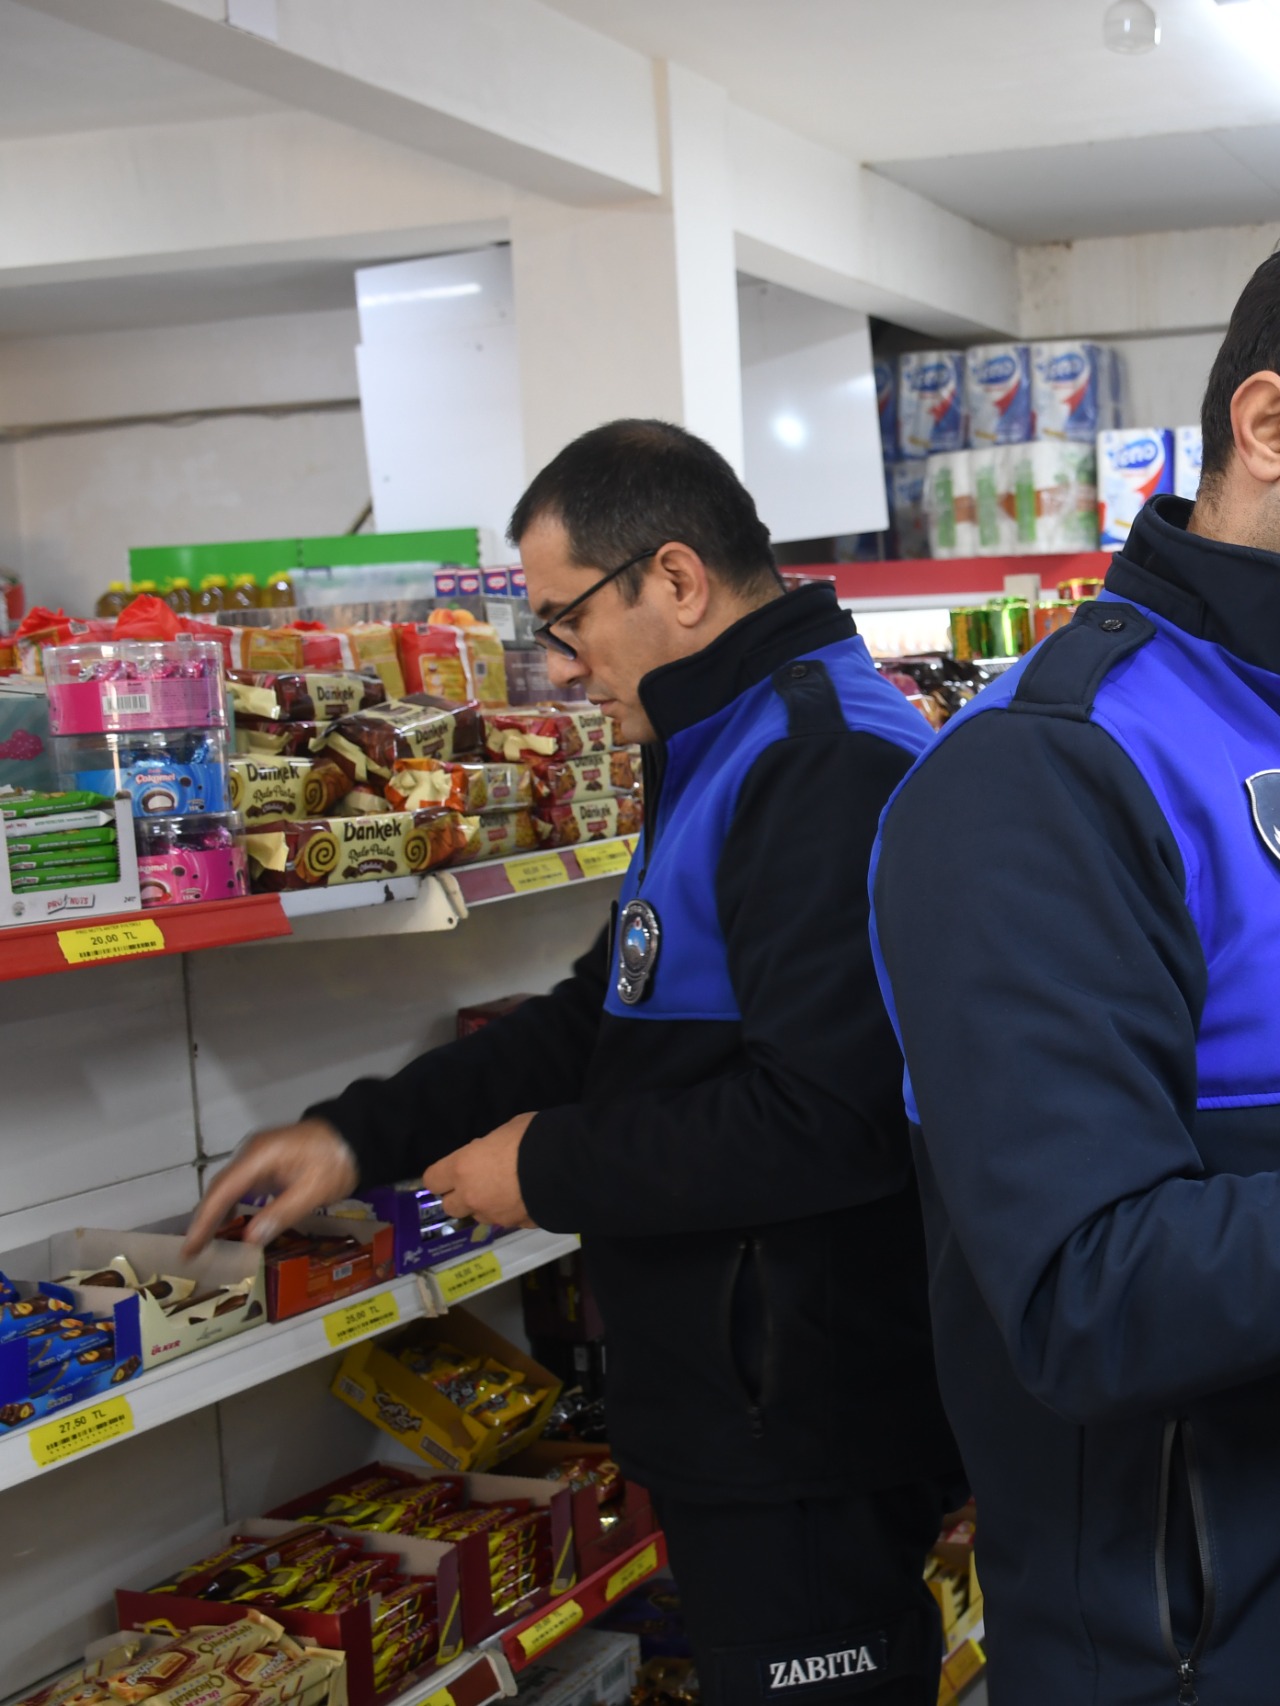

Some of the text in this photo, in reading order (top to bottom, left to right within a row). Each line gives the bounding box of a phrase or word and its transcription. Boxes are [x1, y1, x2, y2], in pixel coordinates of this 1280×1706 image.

[317, 686, 354, 702] Dankek
[415, 719, 449, 744] Dankek
[579, 804, 612, 821] Dankek
[343, 819, 402, 842] Dankek
[70, 897, 89, 905] NUTS
[91, 932, 138, 945] 20,00 TL
[151, 1340, 181, 1356] ÜLKER
[59, 1410, 106, 1434] 27,50 TL
[769, 1646, 878, 1689] ZABITA
